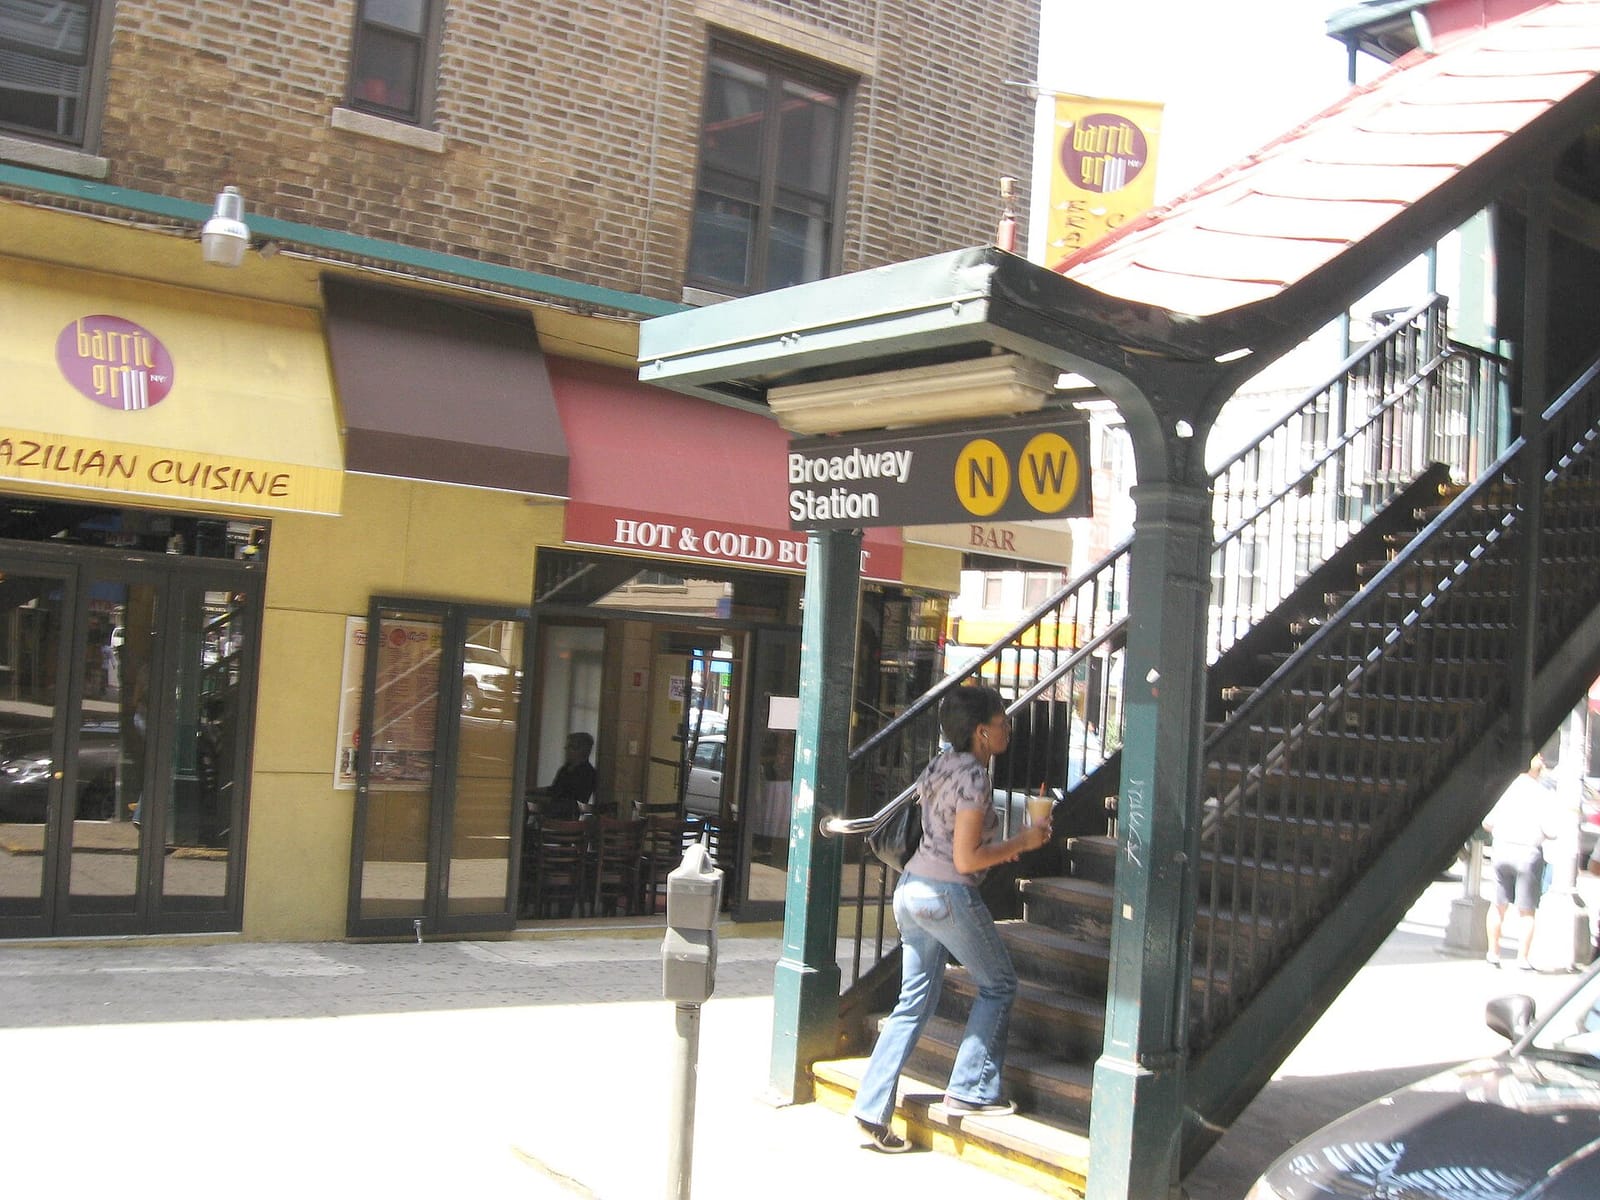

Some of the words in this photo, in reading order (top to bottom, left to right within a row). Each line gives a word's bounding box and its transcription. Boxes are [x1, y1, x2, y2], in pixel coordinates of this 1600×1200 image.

[76, 318, 155, 368] barril
[92, 364, 148, 411] grill
[147, 459, 290, 497] CUISINE
[788, 448, 913, 484] Broadway
[969, 456, 994, 498] N
[1028, 450, 1067, 495] W
[789, 488, 879, 521] Station
[614, 519, 676, 549] HOT
[678, 526, 701, 552] &
[703, 530, 773, 561] COLD
[970, 525, 1017, 552] BAR
